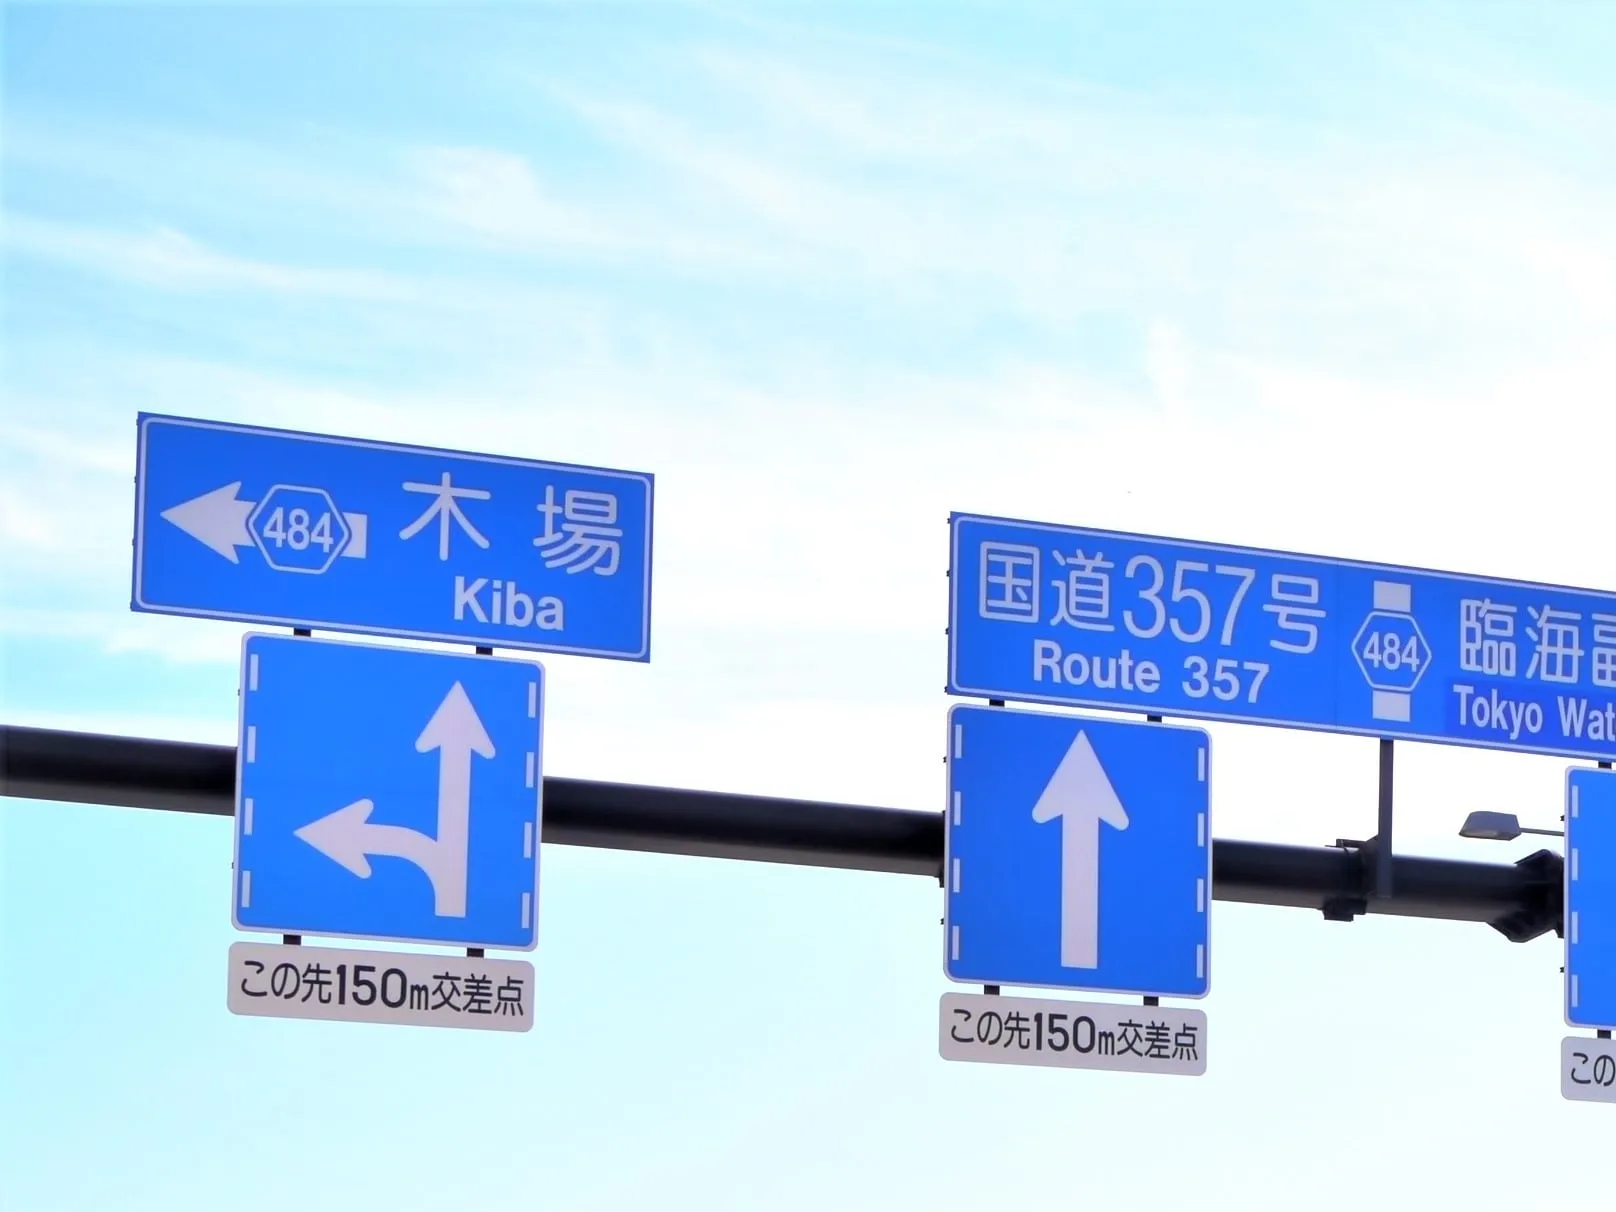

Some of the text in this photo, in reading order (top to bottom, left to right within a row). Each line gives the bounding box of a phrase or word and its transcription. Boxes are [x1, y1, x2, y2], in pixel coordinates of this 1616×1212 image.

[262, 506, 334, 553] 484
[400, 471, 622, 577] 木場
[453, 575, 565, 632] Kiba
[979, 540, 1326, 654] 国道357号
[1032, 639, 1270, 704] Route 357
[1362, 631, 1420, 673] 484
[1452, 684, 1543, 741] Tokyo
[240, 960, 524, 1018] この先150m交差点
[950, 1009, 1199, 1062] この先150m交差点
